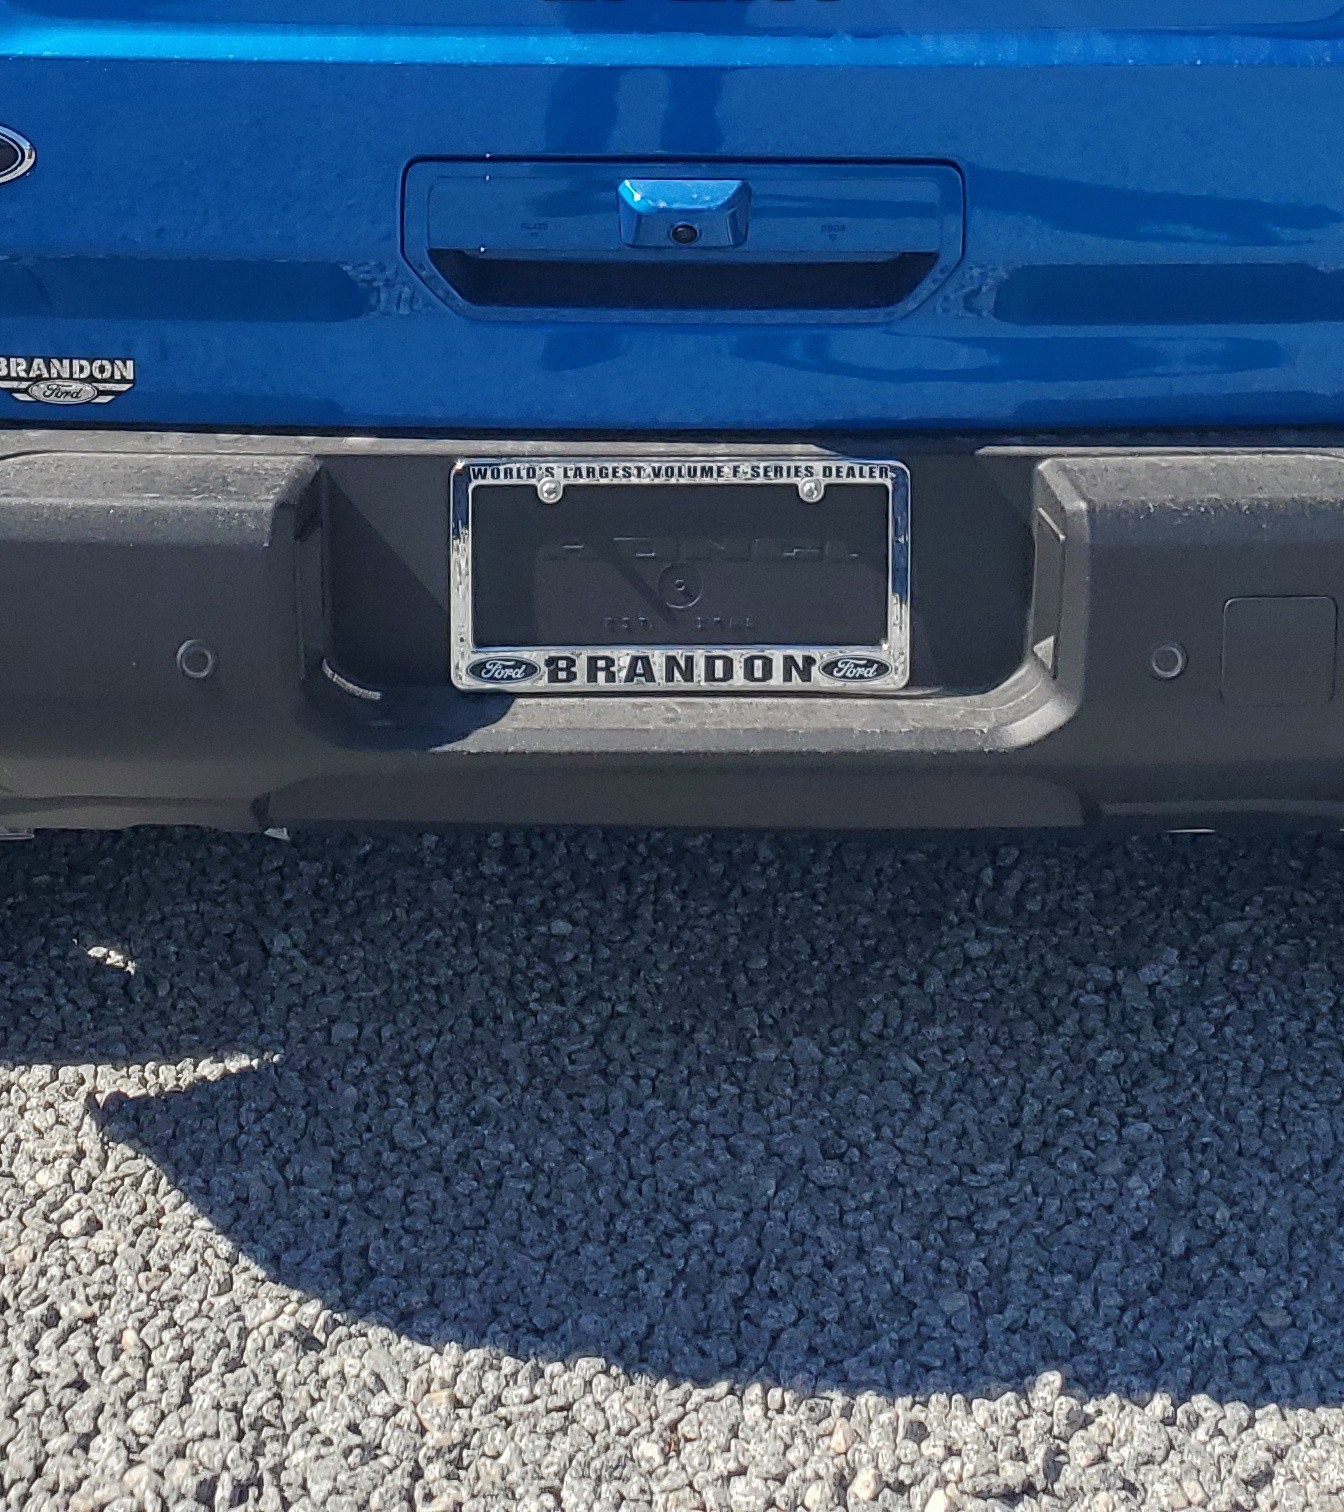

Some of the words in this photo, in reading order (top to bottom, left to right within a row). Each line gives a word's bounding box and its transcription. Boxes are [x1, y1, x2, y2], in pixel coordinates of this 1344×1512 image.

[42, 383, 83, 400] Ford
[471, 465, 556, 480] WORLD'S
[562, 465, 648, 480] LARGEST
[650, 465, 726, 480] VOLUME
[822, 465, 890, 479] DEALER
[481, 660, 526, 679] Ford
[545, 654, 814, 684] BRANDON
[832, 658, 878, 679] Ford
